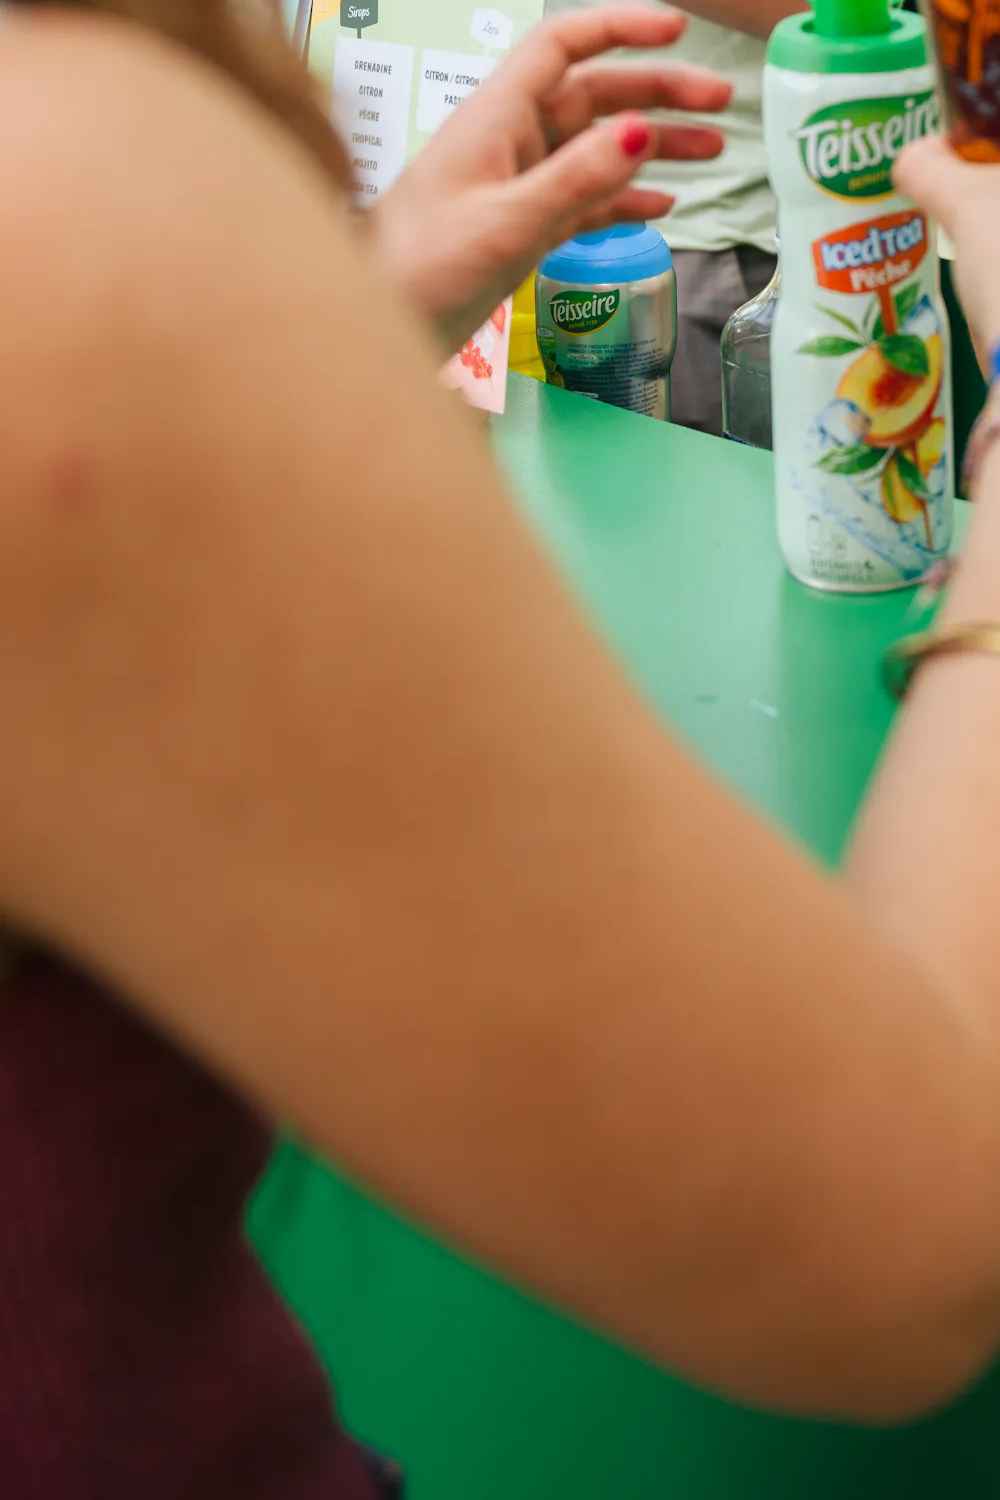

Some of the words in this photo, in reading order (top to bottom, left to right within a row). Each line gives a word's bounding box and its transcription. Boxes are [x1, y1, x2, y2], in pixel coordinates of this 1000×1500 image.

[347, 5, 370, 20] Sirops
[354, 60, 392, 74] GRENADINE
[424, 69, 449, 83] CITRON
[455, 75, 480, 88] CITRON
[359, 85, 383, 98] CITRON
[352, 133, 383, 147] TROPICAL
[367, 184, 378, 196] TEA
[549, 294, 616, 323] Teisseire
